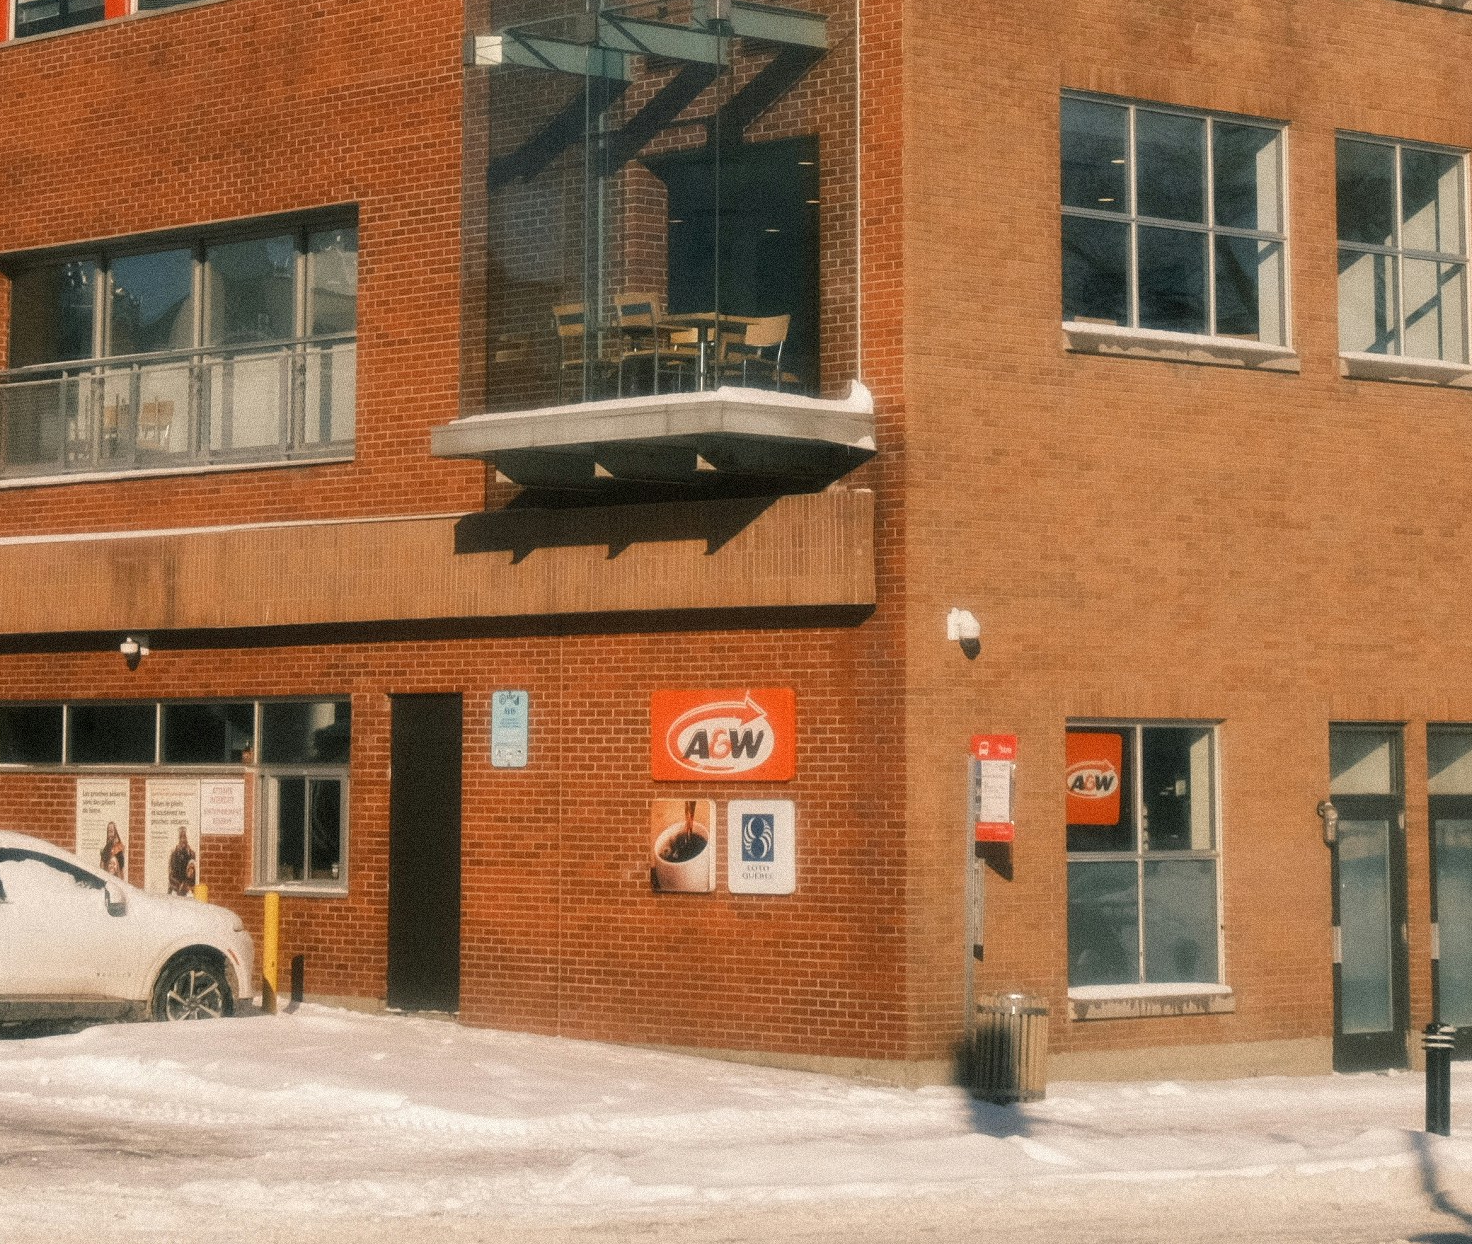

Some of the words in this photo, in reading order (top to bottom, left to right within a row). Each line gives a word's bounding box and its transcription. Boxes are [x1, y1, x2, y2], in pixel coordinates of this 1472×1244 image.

[683, 728, 765, 760] A&W
[1070, 773, 1115, 792] A&W
[747, 864, 770, 872] LOTO
